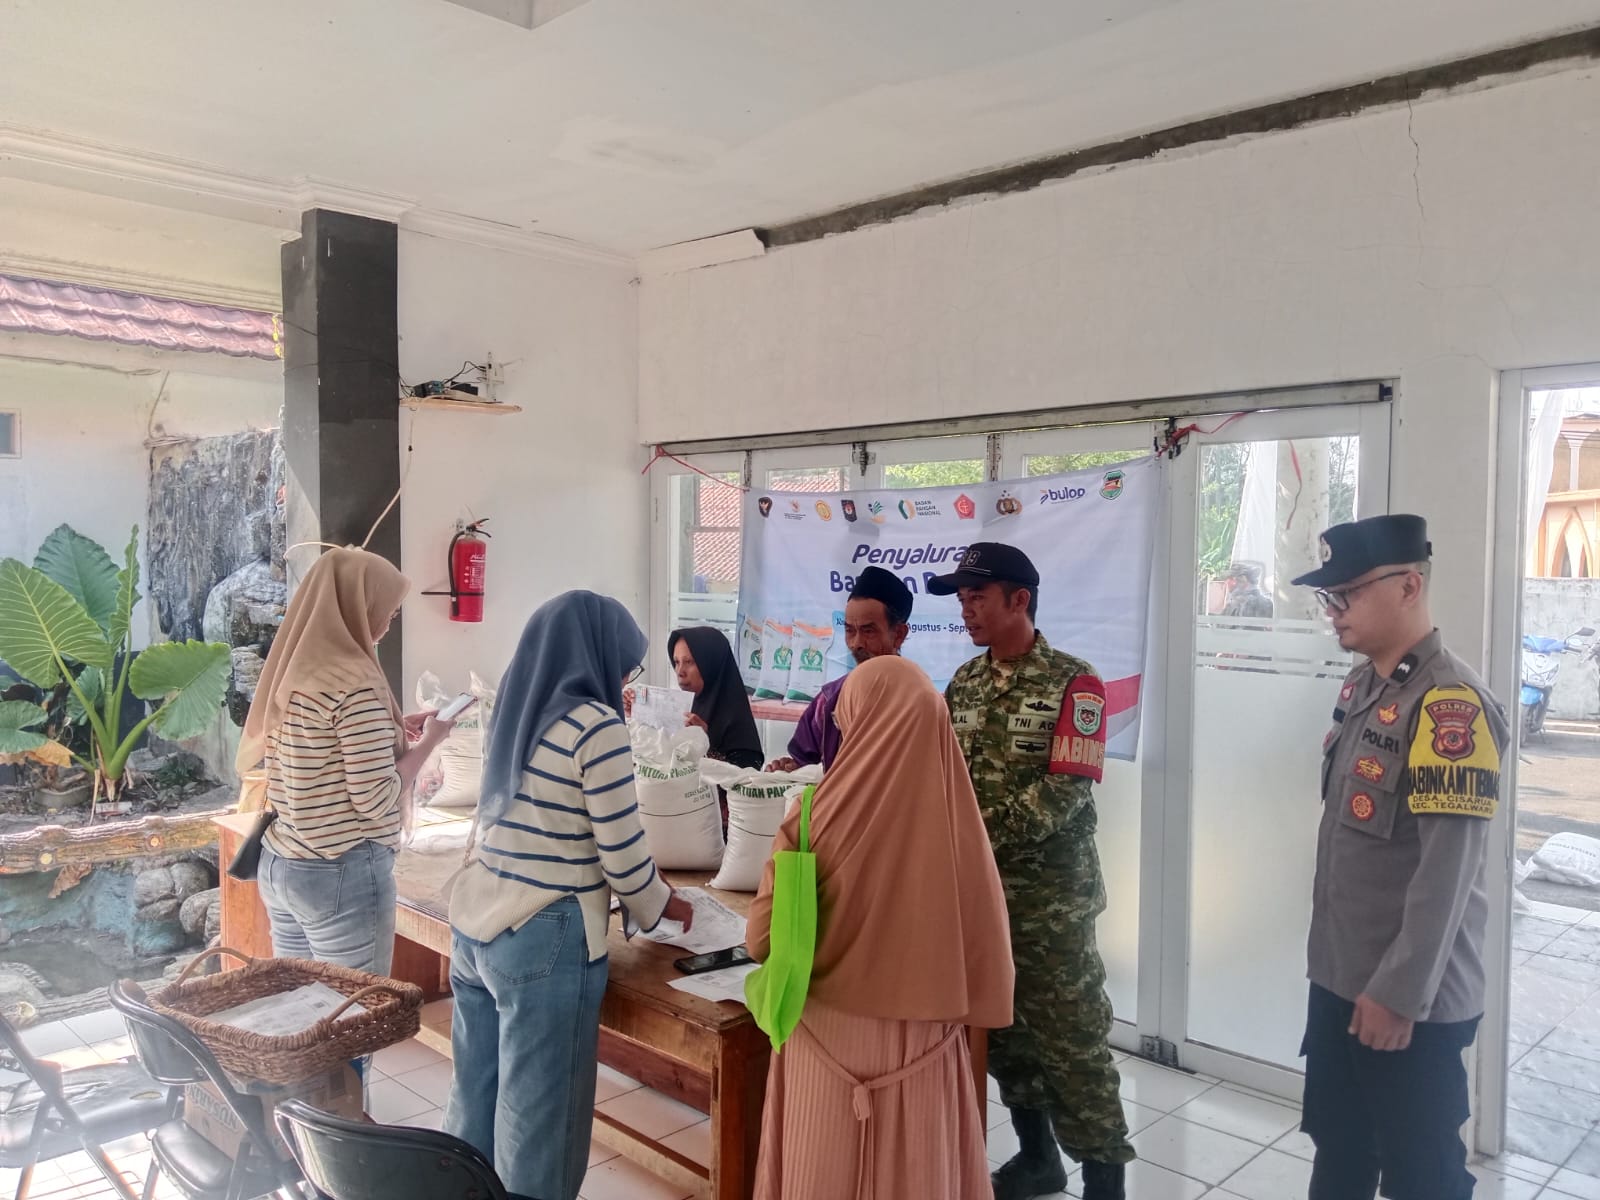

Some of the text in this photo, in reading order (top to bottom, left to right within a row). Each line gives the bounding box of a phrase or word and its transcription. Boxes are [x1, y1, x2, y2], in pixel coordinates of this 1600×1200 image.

[852, 543, 968, 570] Penyalura
[1432, 703, 1473, 713] POLRES
[1015, 717, 1031, 728] TNI
[1361, 727, 1399, 754] POLRI
